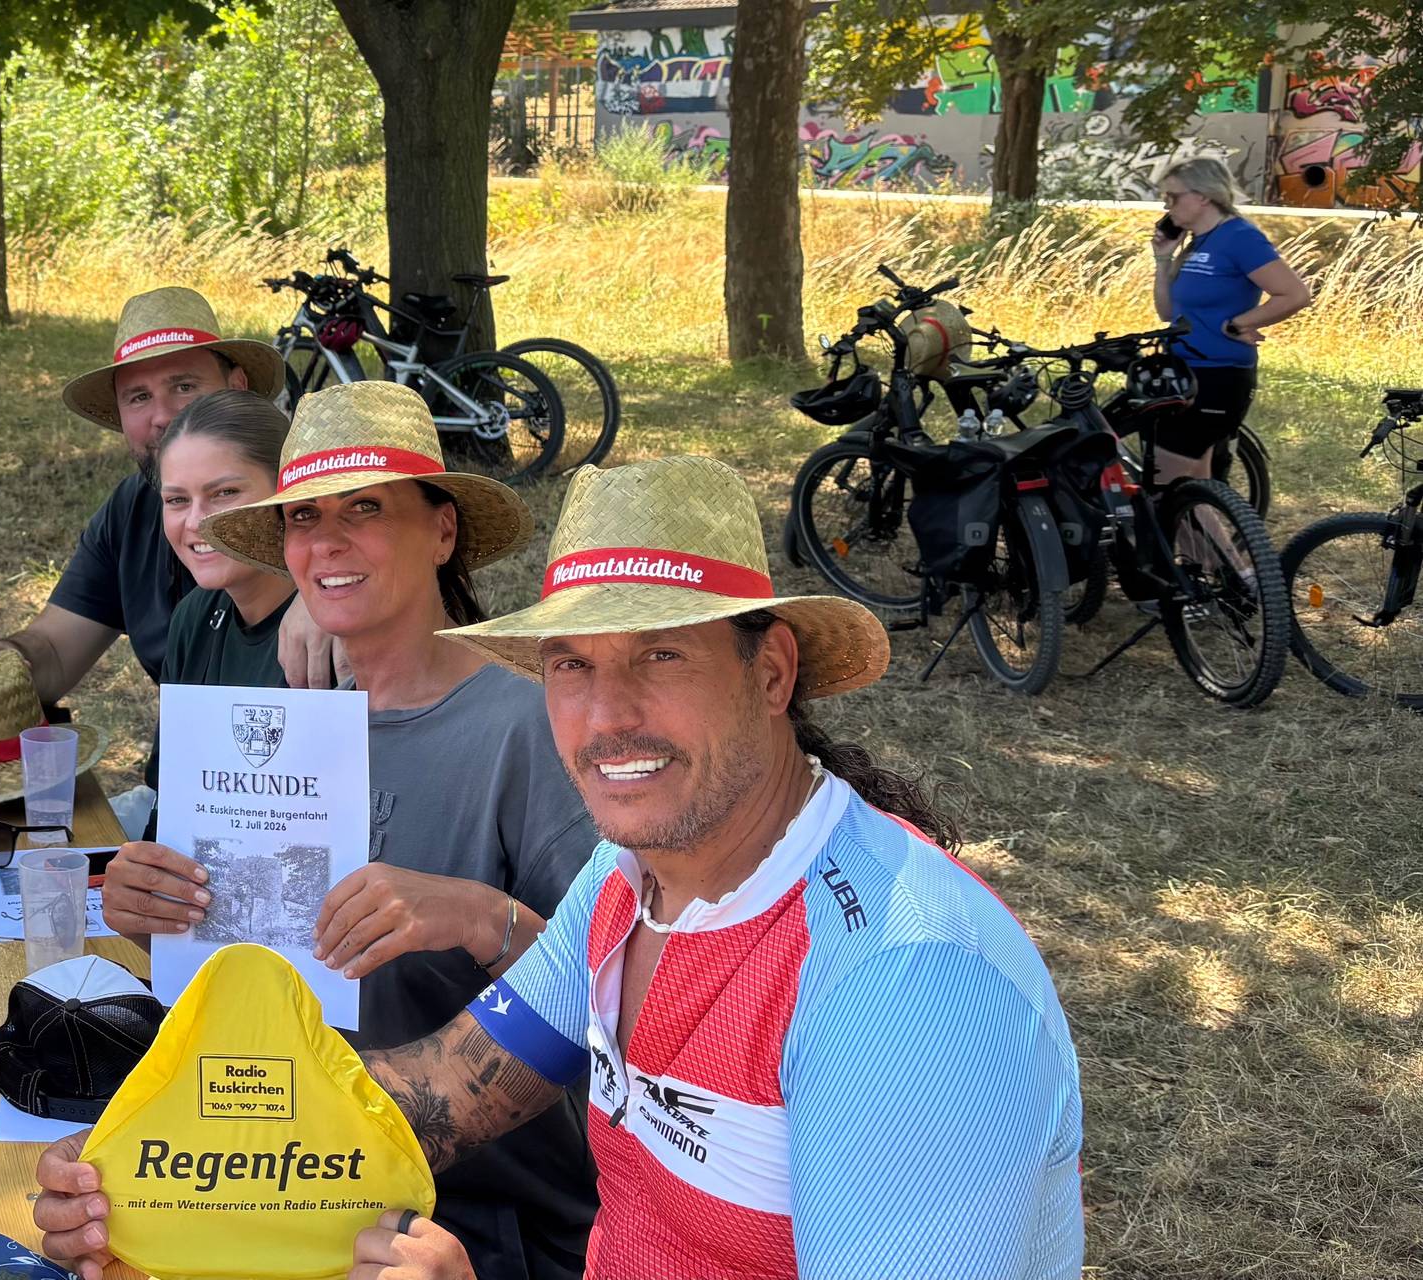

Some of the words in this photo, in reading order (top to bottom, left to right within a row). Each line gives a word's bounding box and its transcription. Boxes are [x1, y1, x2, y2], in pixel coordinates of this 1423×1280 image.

[283, 452, 387, 487] Heimatstädtche
[553, 557, 704, 586] Heimatstädtche
[201, 769, 321, 798] URKUNDE
[195, 803, 208, 814] 34.
[210, 804, 267, 818] Euskirchener
[270, 809, 328, 821] Burgenfahrt
[230, 819, 243, 829] 12.
[246, 820, 262, 830] Juli
[264, 822, 287, 832] 2026
[225, 1065, 267, 1078] Radio
[209, 1081, 285, 1095] Euskirchen
[134, 1139, 366, 1193] Regenfest
[128, 1198, 147, 1209] mit
[149, 1199, 173, 1209] dem
[177, 1199, 257, 1211] Wetterservice
[260, 1201, 280, 1211] von
[283, 1199, 317, 1210] Radio
[320, 1199, 387, 1210] Euskirchen.
